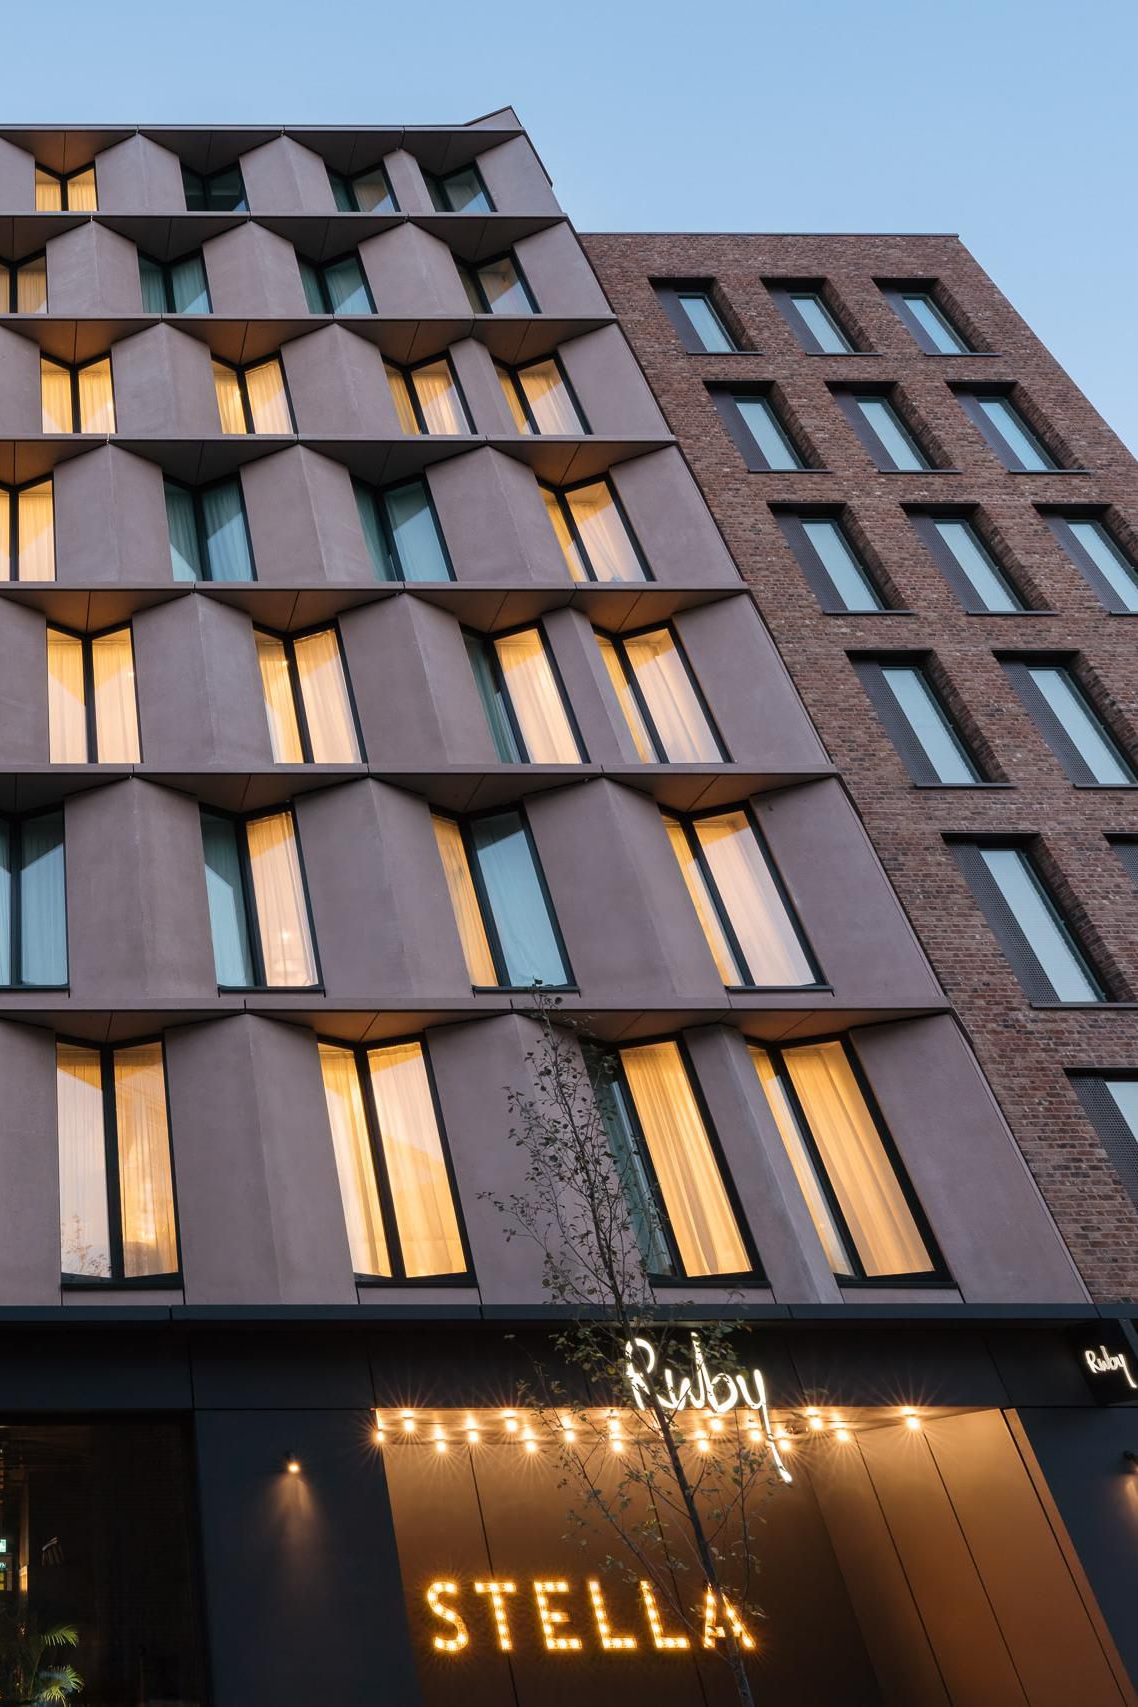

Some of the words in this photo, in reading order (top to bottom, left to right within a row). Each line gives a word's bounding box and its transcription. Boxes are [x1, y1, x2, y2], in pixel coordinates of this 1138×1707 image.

[1084, 1345, 1137, 1389] Ruby
[625, 1331, 793, 1482] Ruby
[426, 1579, 758, 1652] STELLA
